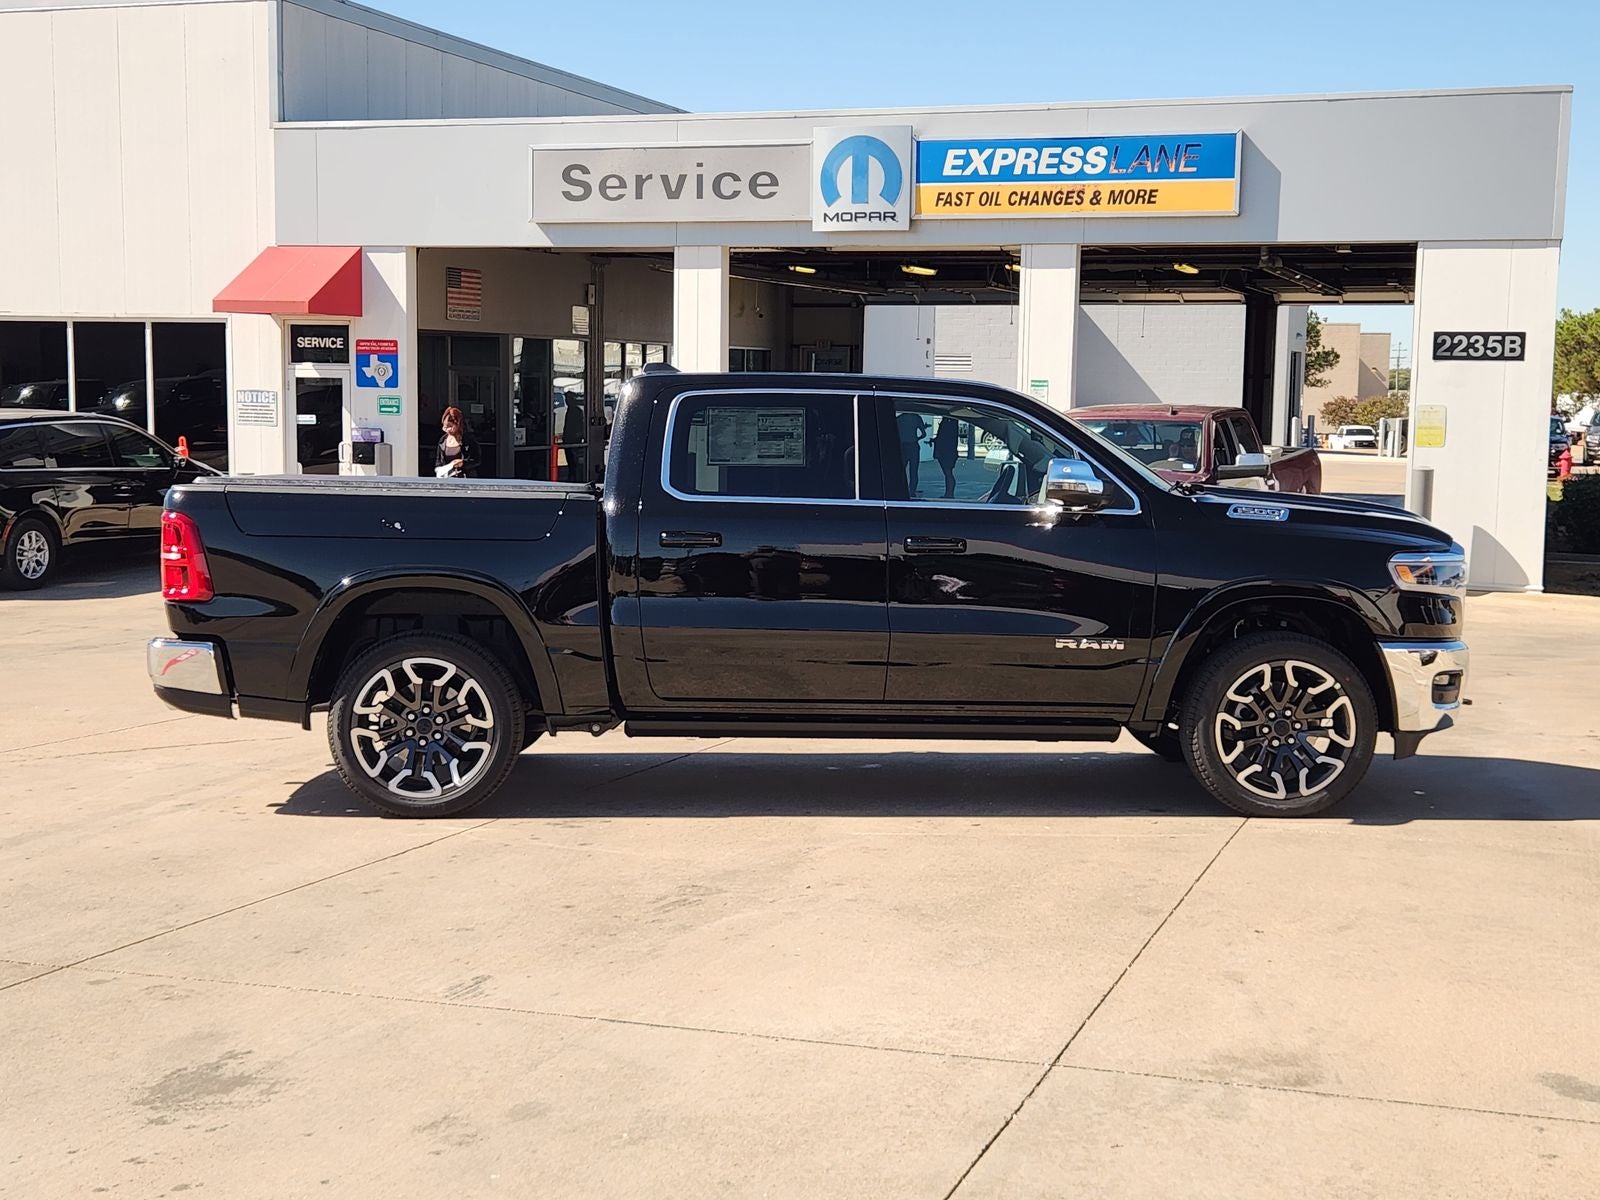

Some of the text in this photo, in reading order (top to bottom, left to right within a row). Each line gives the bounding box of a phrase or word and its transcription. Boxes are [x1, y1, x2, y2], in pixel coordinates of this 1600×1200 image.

[942, 143, 1203, 176] EXPRESS LANE
[561, 162, 780, 202] Service
[935, 188, 1159, 207] FAST OIL CHANGES & MORE
[823, 211, 898, 223] MOPAR
[296, 336, 345, 349] SERVICE
[1435, 334, 1523, 358] 2235B
[236, 390, 277, 404] NOTICE
[1055, 638, 1125, 650] RAM
